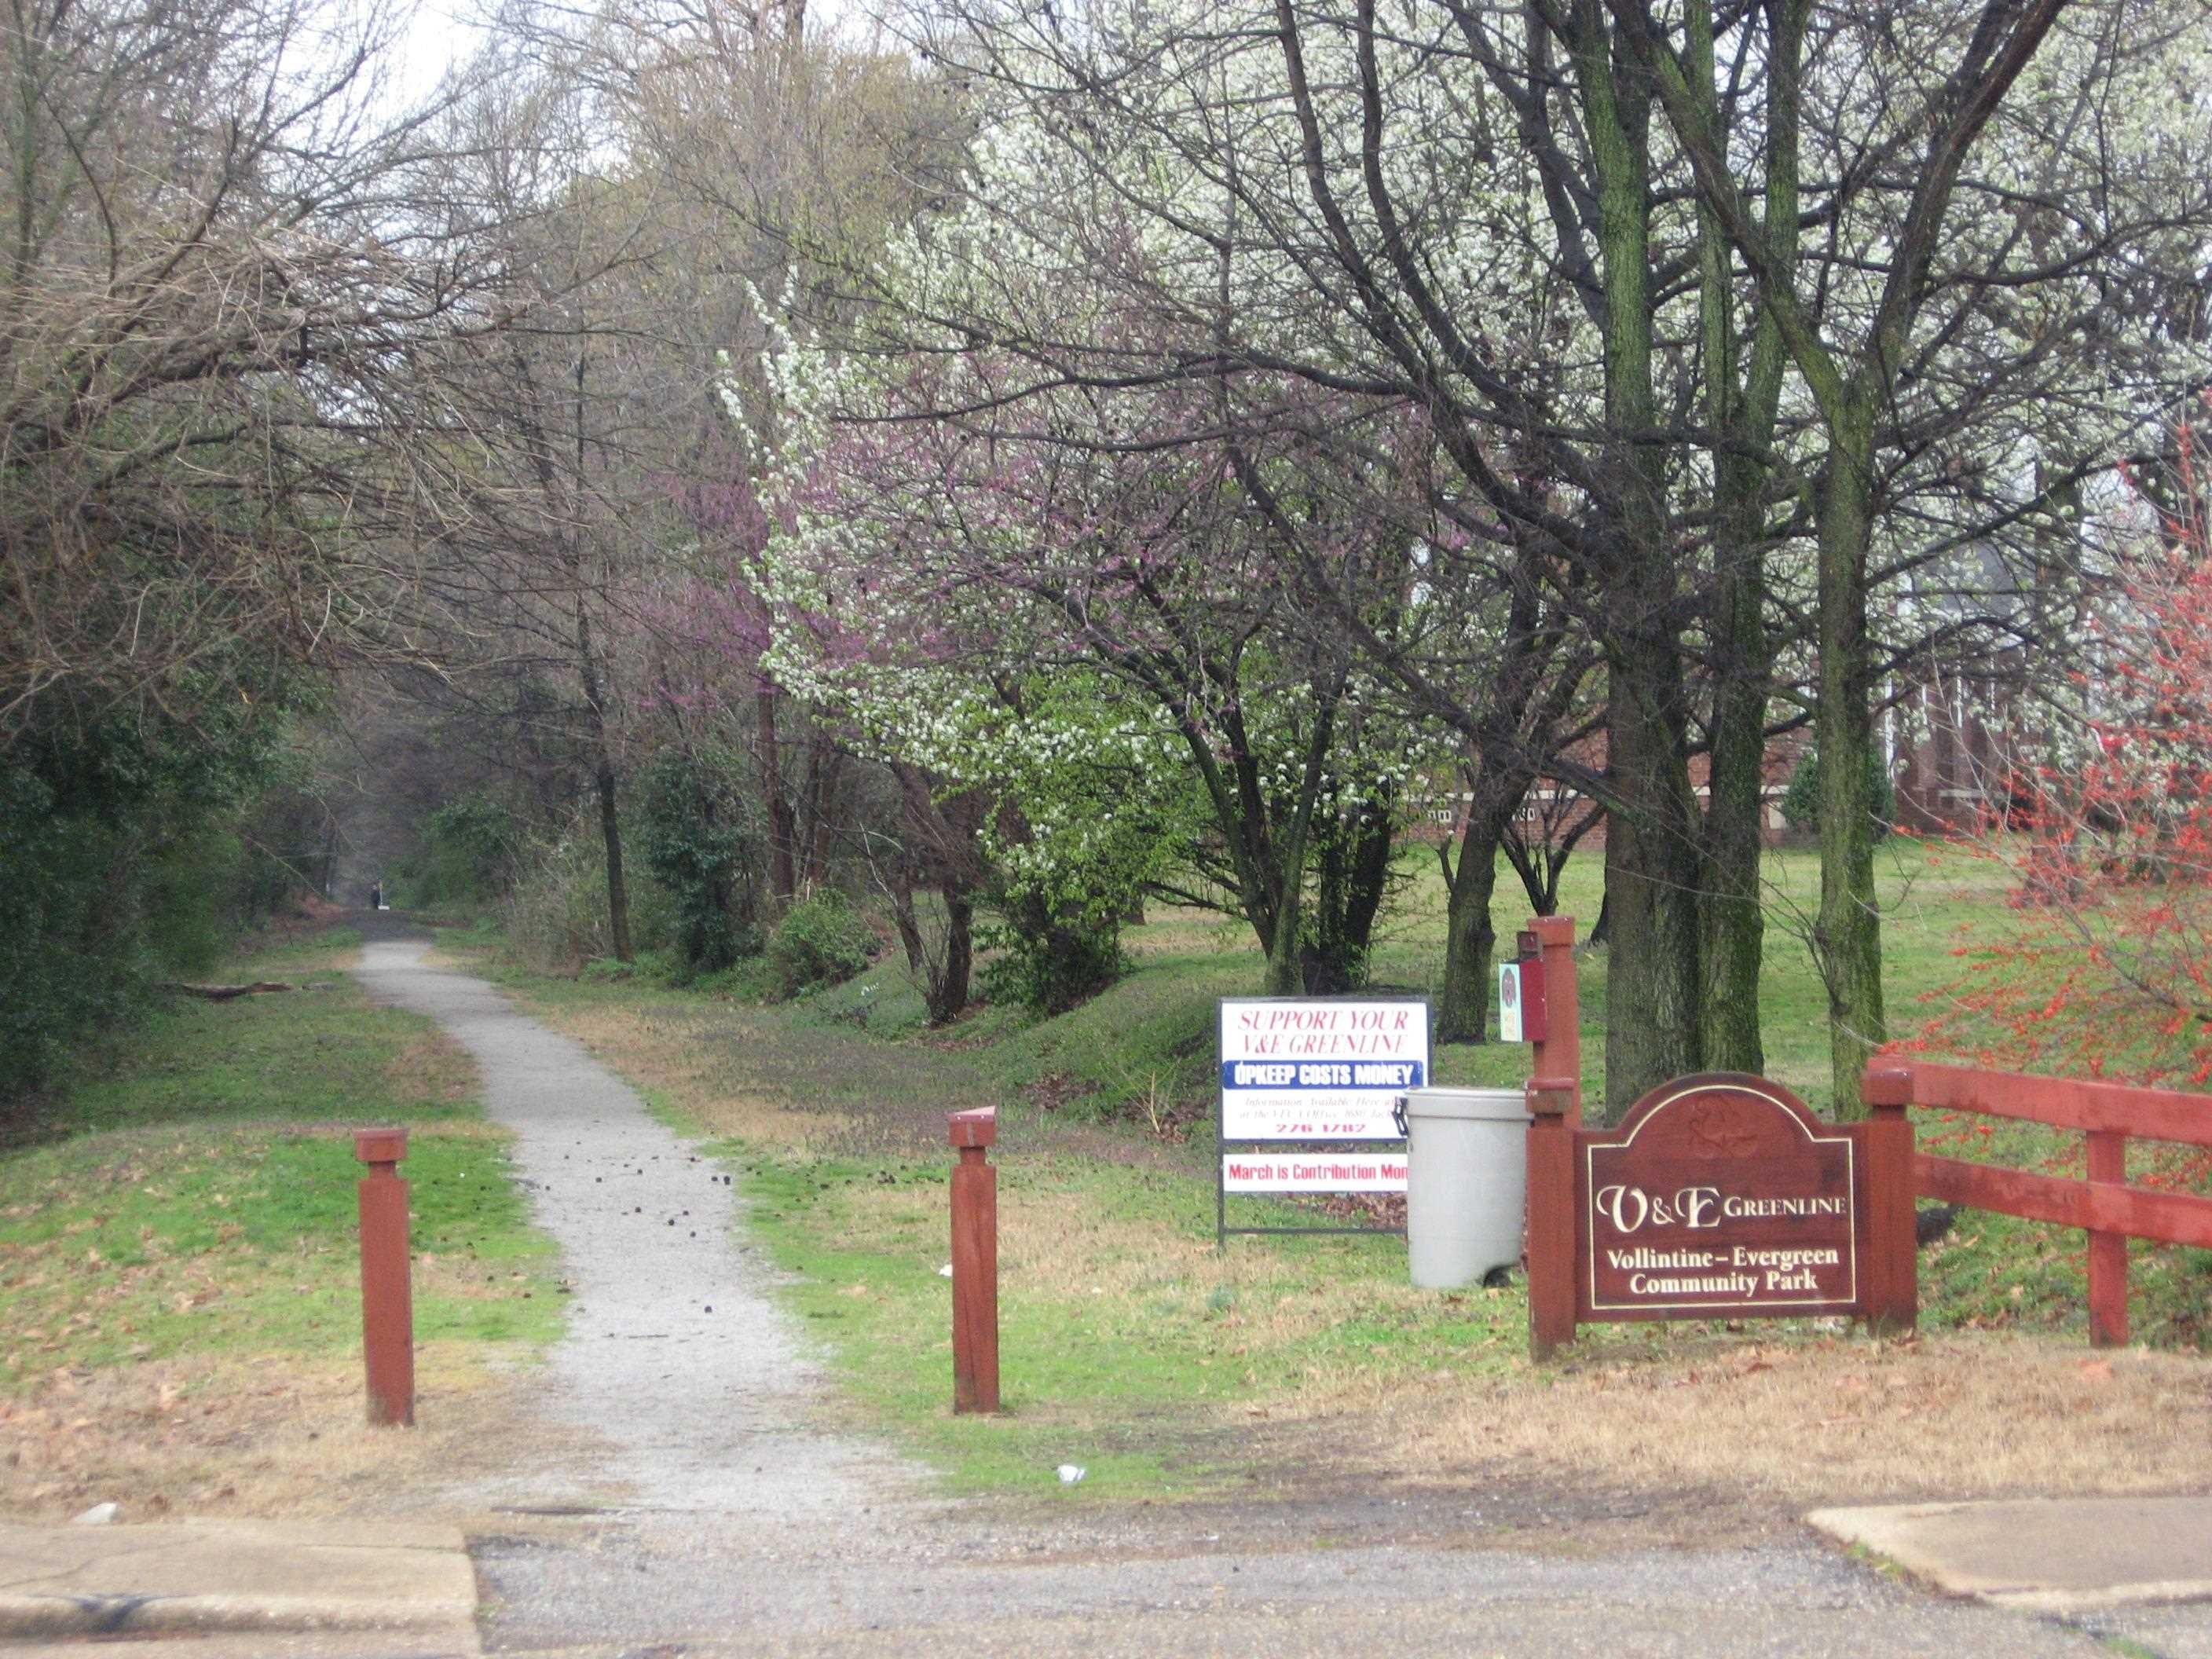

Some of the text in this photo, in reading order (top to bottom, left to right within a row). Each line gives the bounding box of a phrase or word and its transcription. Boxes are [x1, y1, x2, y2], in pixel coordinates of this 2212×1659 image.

[1238, 1010, 1409, 1031] SUPPORT YOUR
[1243, 1035, 1408, 1054] V&E GREENLINE
[1235, 1064, 1413, 1085] UPKEEP COSTS MONEY
[1229, 1163, 1408, 1180] March is Contribution Mon
[1723, 1196, 1846, 1217] GREENLINE
[1629, 1268, 1818, 1297] Community Park
